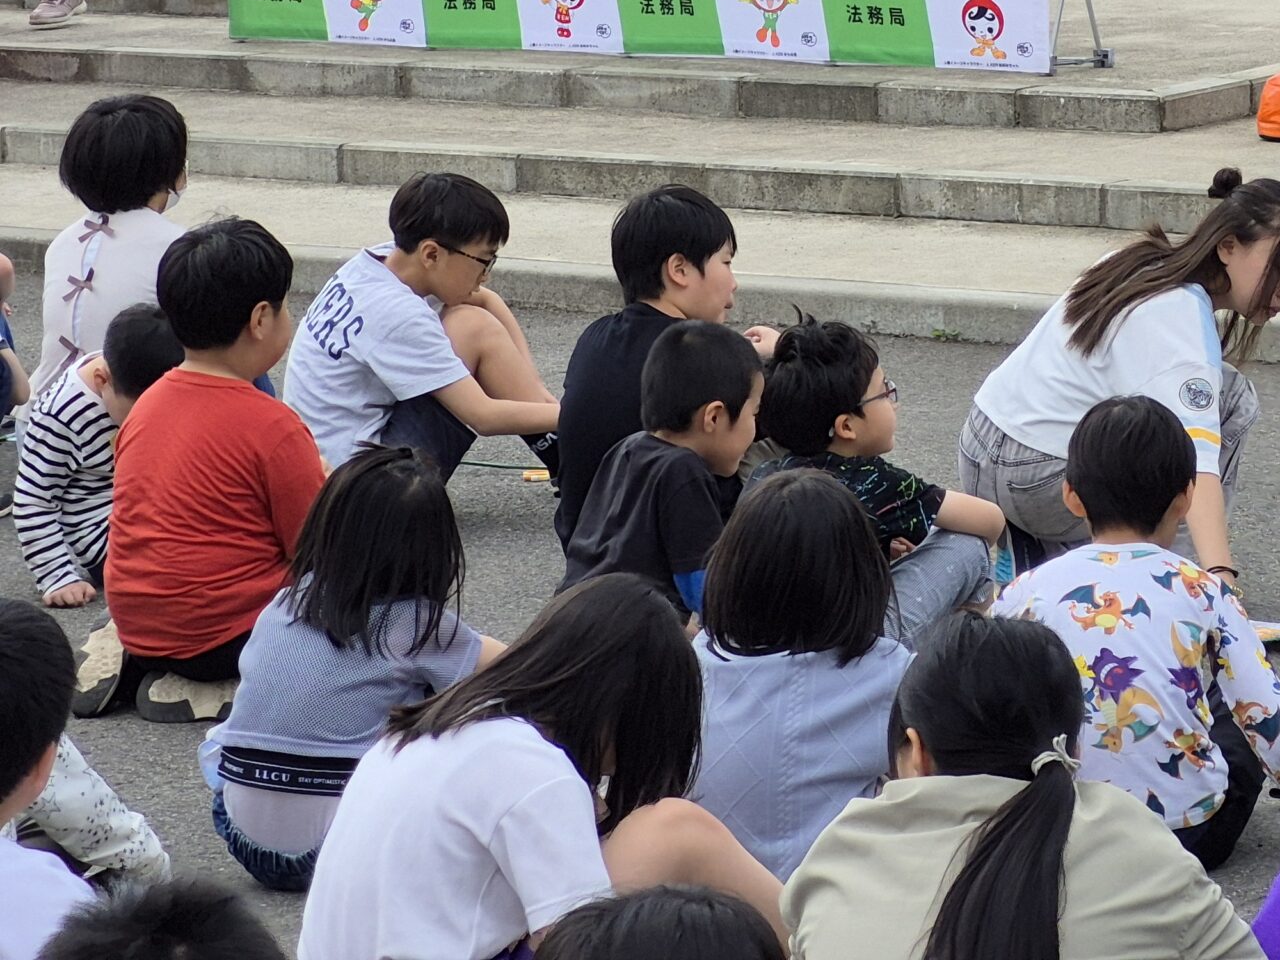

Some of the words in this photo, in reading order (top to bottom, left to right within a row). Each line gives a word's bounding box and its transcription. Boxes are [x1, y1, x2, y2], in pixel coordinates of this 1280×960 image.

[847, 5, 904, 26] 法務局
[305, 274, 364, 361] ERS
[255, 769, 291, 782] LLCU
